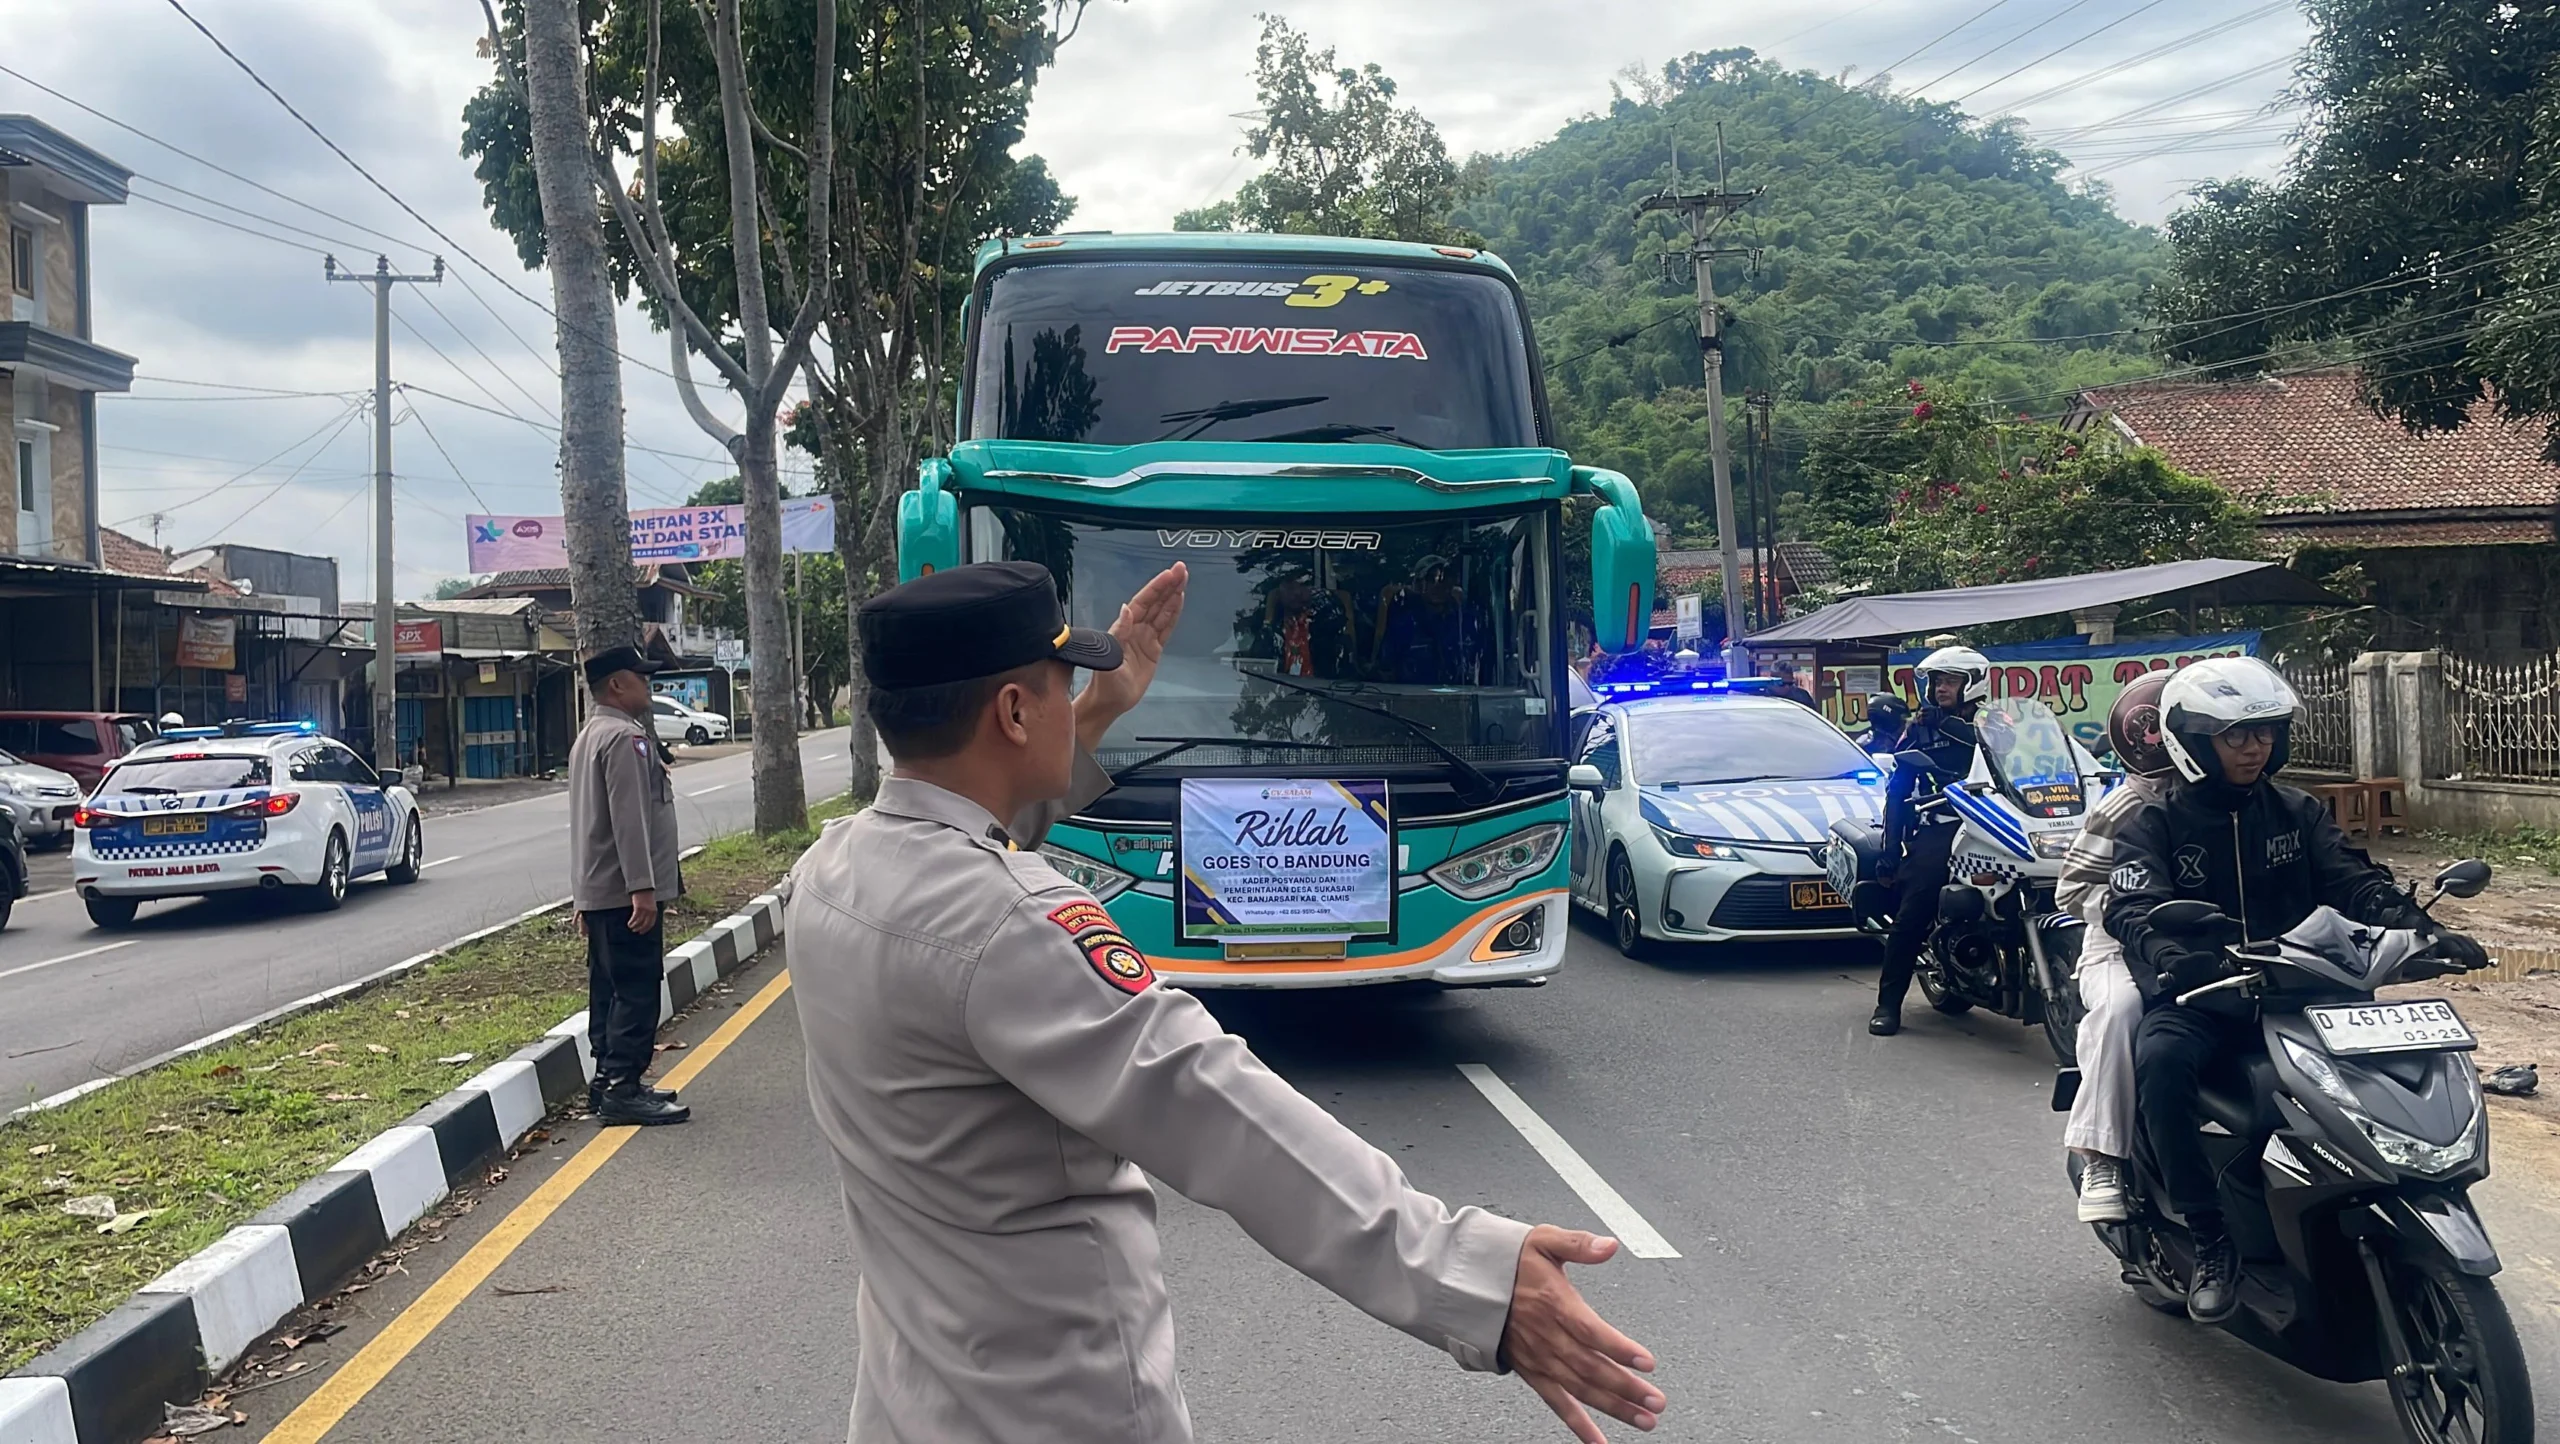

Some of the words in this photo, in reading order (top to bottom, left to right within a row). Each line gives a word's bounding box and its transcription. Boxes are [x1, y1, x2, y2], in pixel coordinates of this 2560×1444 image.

[1134, 280, 1298, 297] JETBUS
[1105, 325, 1429, 360] PARIWISATA
[698, 509, 725, 525] 3X
[516, 525, 539, 533] AXIS
[653, 530, 693, 544] DAN
[1156, 529, 1382, 550] VOYAGER
[398, 630, 423, 641] SPX
[1692, 784, 1884, 802] POLISI
[2049, 785, 2070, 793] VIII
[360, 809, 383, 833] POLISI
[1235, 807, 1348, 848] Rihlah
[2048, 819, 2075, 828] YAMAHA
[1202, 855, 1251, 870] GOES
[1256, 855, 1279, 869] TO
[1284, 854, 1370, 869] BANDUNG
[1242, 877, 1269, 885] KADER
[1272, 876, 1317, 885] POSYANDU
[1223, 886, 1289, 894] PEMERINTAHAN
[1314, 885, 1355, 893] SUKASARI
[1227, 896, 1245, 904] KEC.
[1247, 895, 1298, 903] BANJARSARI
[1321, 894, 1350, 902] CIAMIS
[2316, 1012, 2334, 1030] D
[2348, 1008, 2404, 1027] 4673
[2312, 1142, 2354, 1177] HONDA
